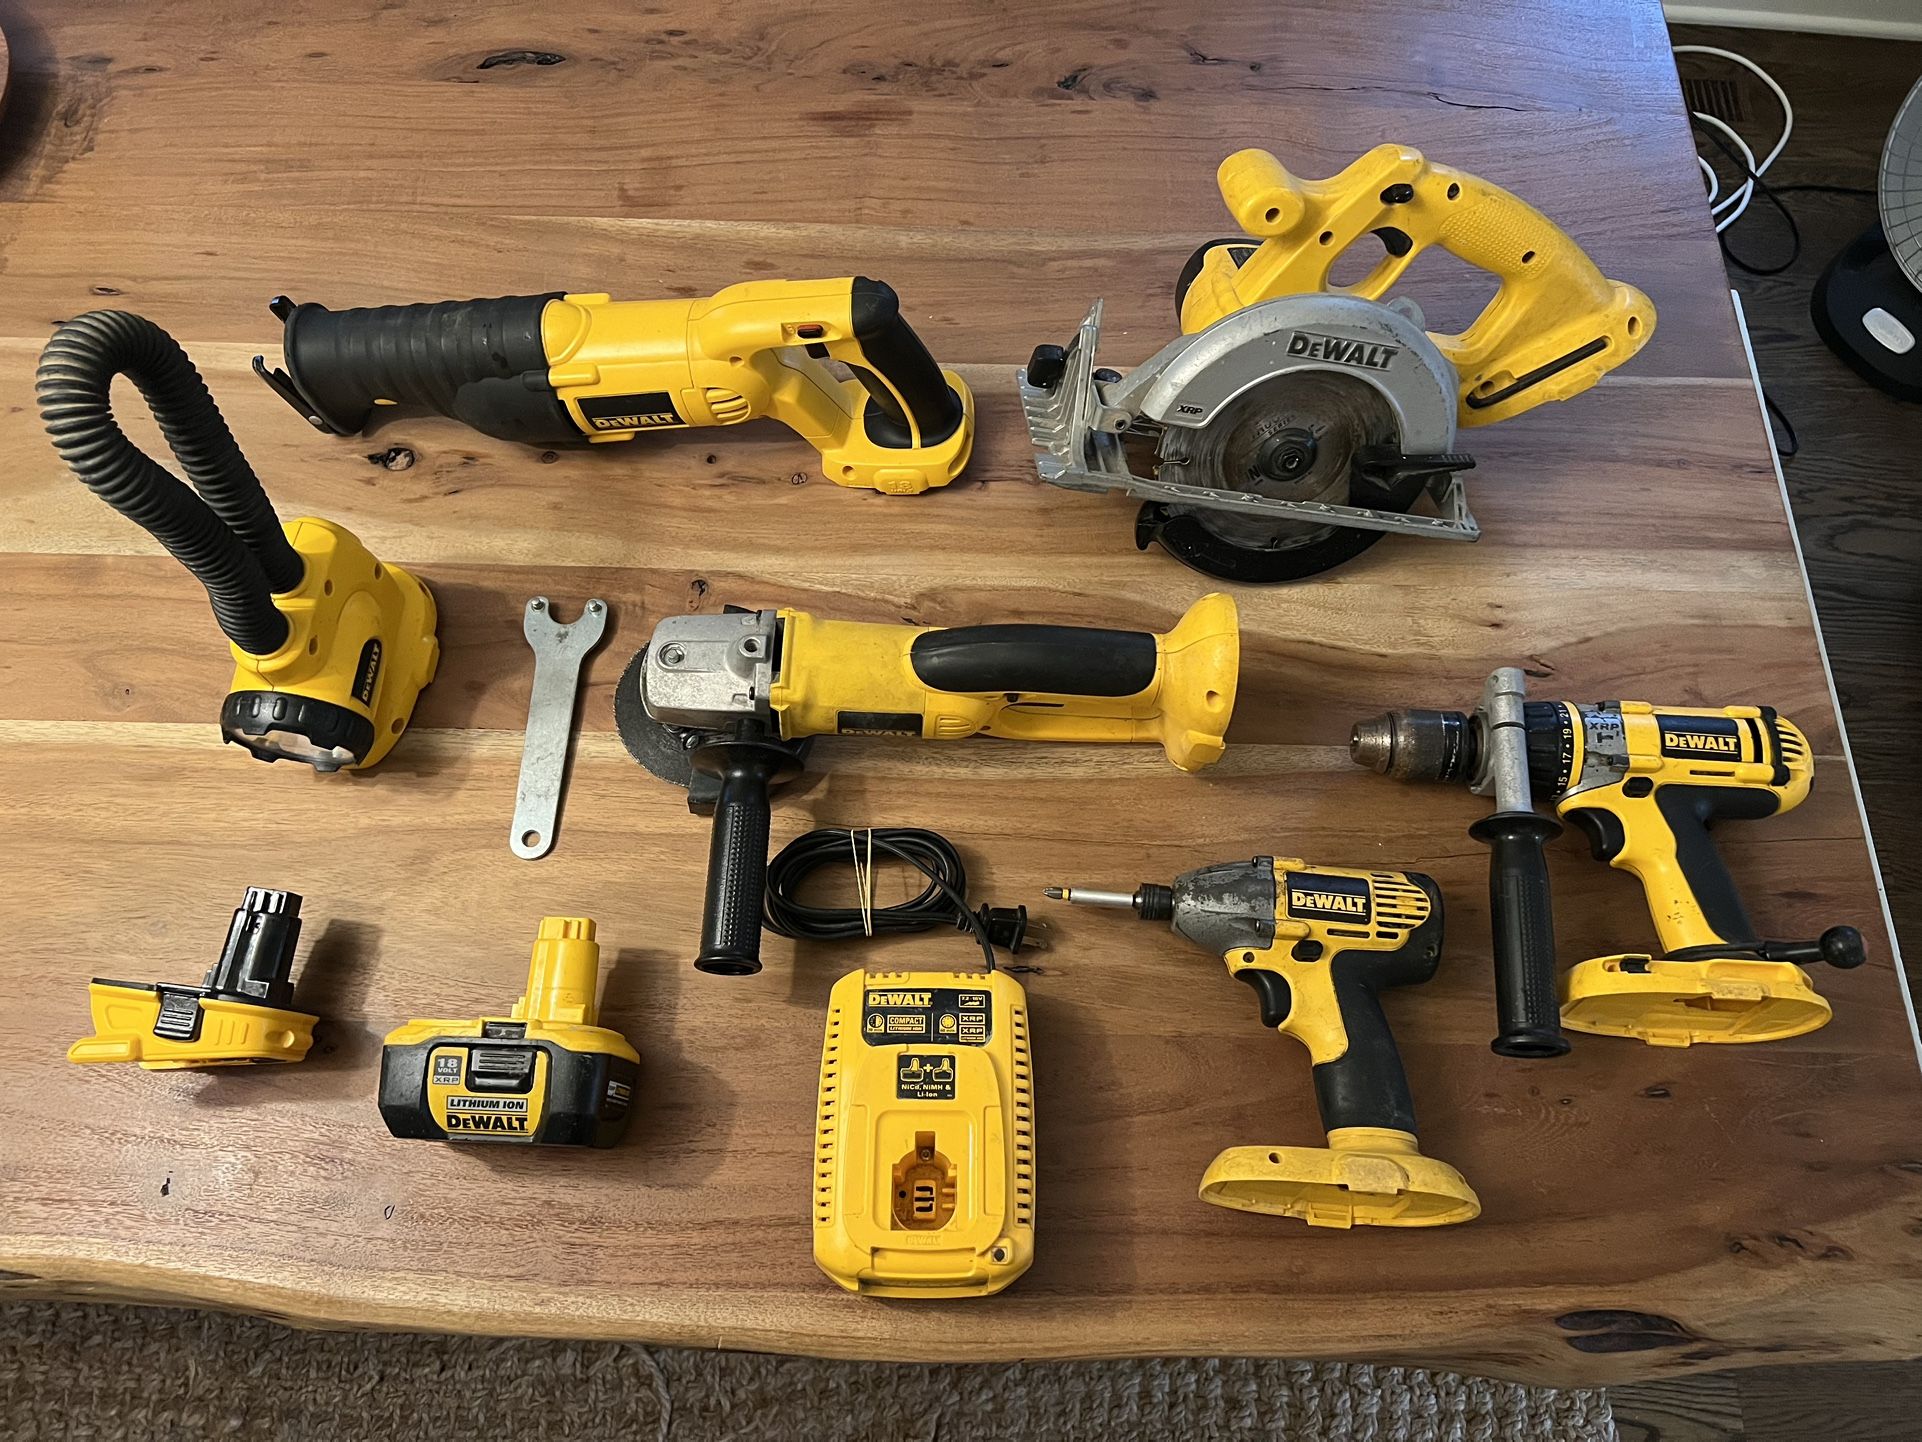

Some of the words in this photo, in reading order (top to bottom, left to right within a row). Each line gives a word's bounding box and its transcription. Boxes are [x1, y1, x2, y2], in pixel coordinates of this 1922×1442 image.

[1286, 332, 1399, 368] DEWALT
[1177, 404, 1203, 414] XRP
[593, 414, 674, 428] DEWALT
[362, 643, 379, 702] DEWALT
[1559, 709, 1569, 718] 21
[1589, 722, 1620, 730] XRP
[1562, 728, 1572, 739] 19
[1664, 733, 1738, 751] DEWALT
[1562, 752, 1572, 764] 17
[1557, 776, 1568, 786] 15
[1291, 891, 1367, 913] DEWALT
[868, 993, 932, 1006] DEWALT
[889, 1017, 923, 1025] COMPACT
[437, 1058, 458, 1068] 18
[450, 1098, 500, 1108] LITHIUM
[502, 1101, 524, 1110] ION
[447, 1115, 528, 1130] DEWALT
